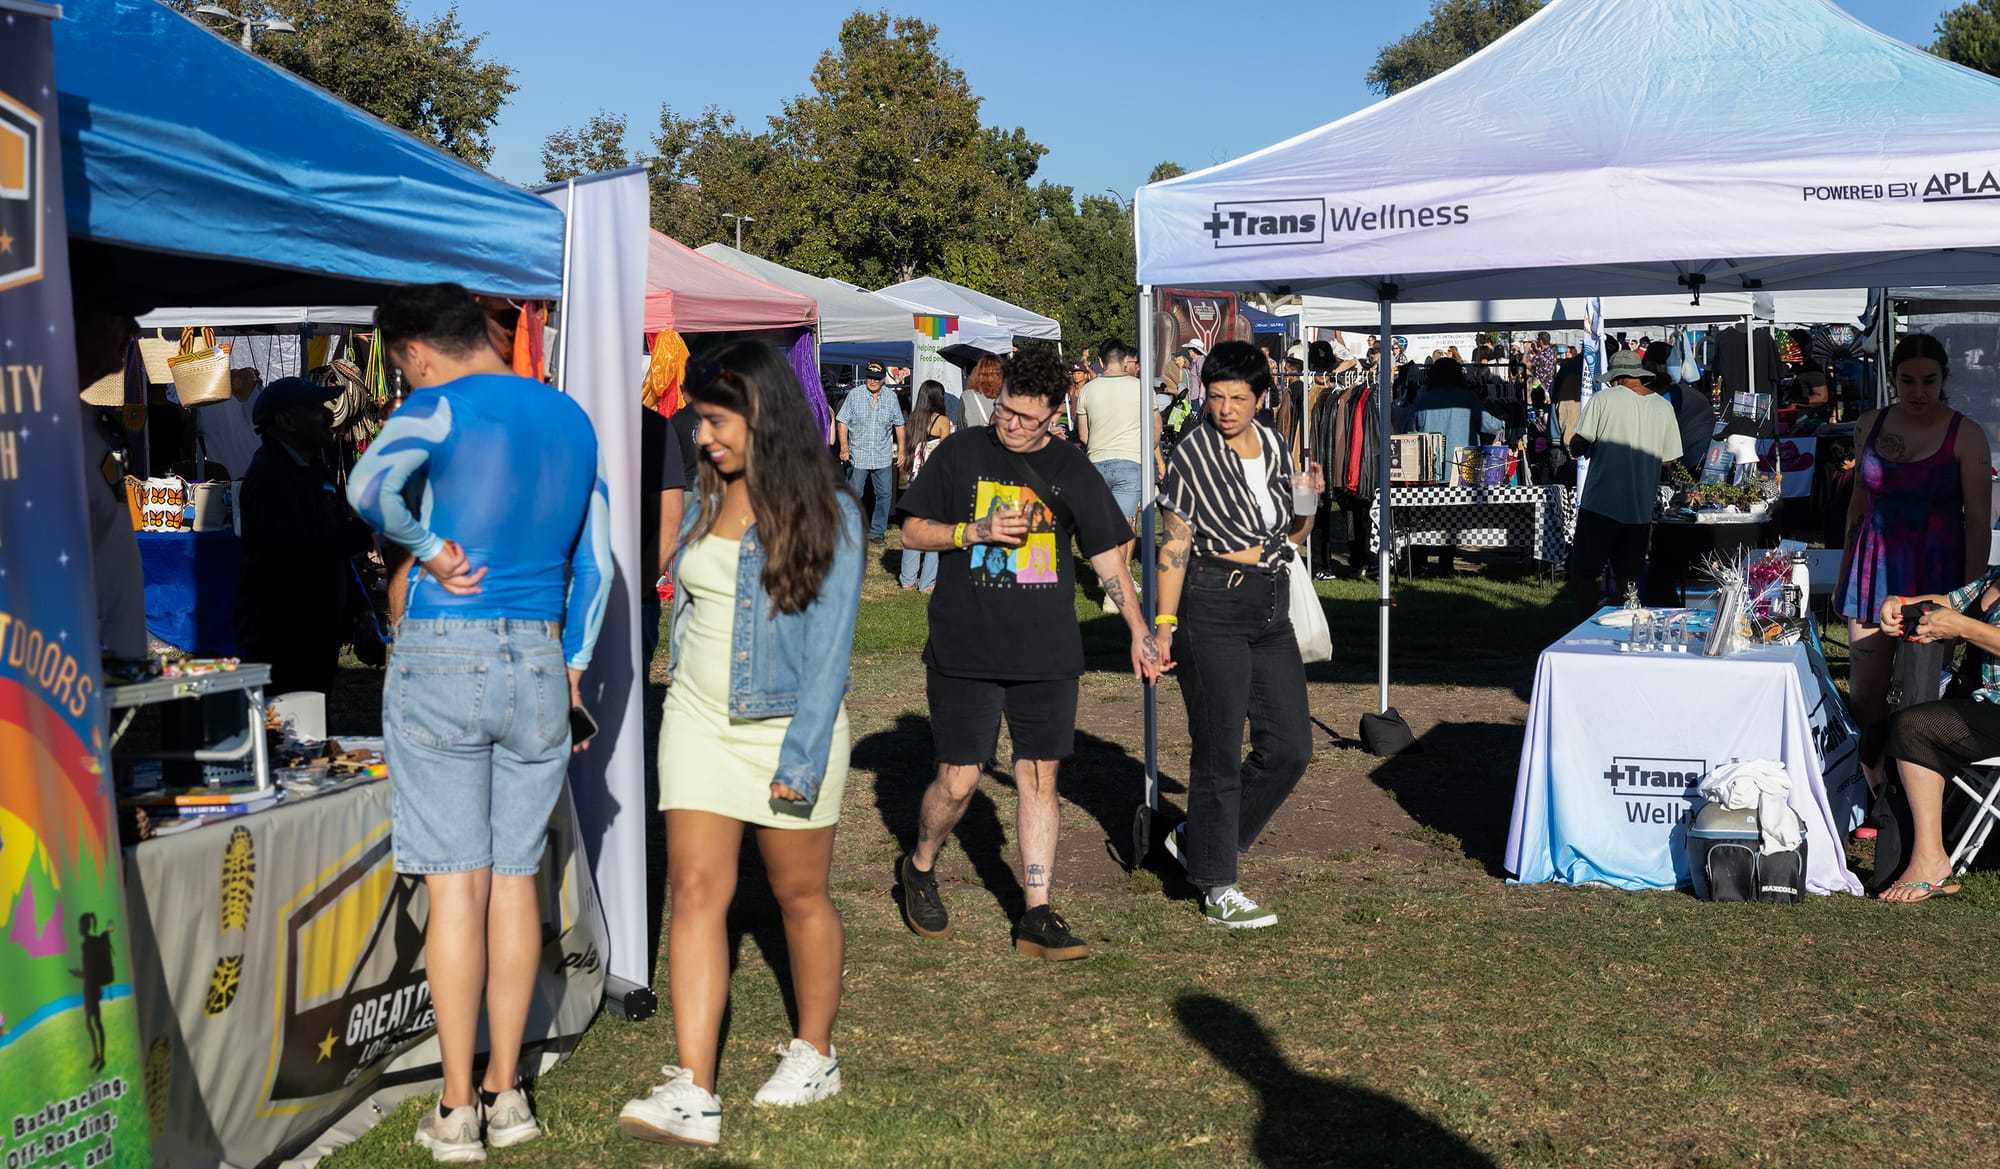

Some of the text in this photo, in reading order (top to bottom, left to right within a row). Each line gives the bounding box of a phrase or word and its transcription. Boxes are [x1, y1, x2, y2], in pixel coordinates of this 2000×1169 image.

[1803, 169, 2000, 201] POWERED BY APLA
[1330, 204, 1469, 232] Wellness
[1626, 801, 1695, 825] Welln
[1761, 885, 1799, 895] MAXCOLD
[345, 984, 416, 1047] GREAT
[13, 1076, 128, 1140] Backpacking,
[6, 1111, 118, 1169] Off-Roading,
[85, 1135, 114, 1168] and
